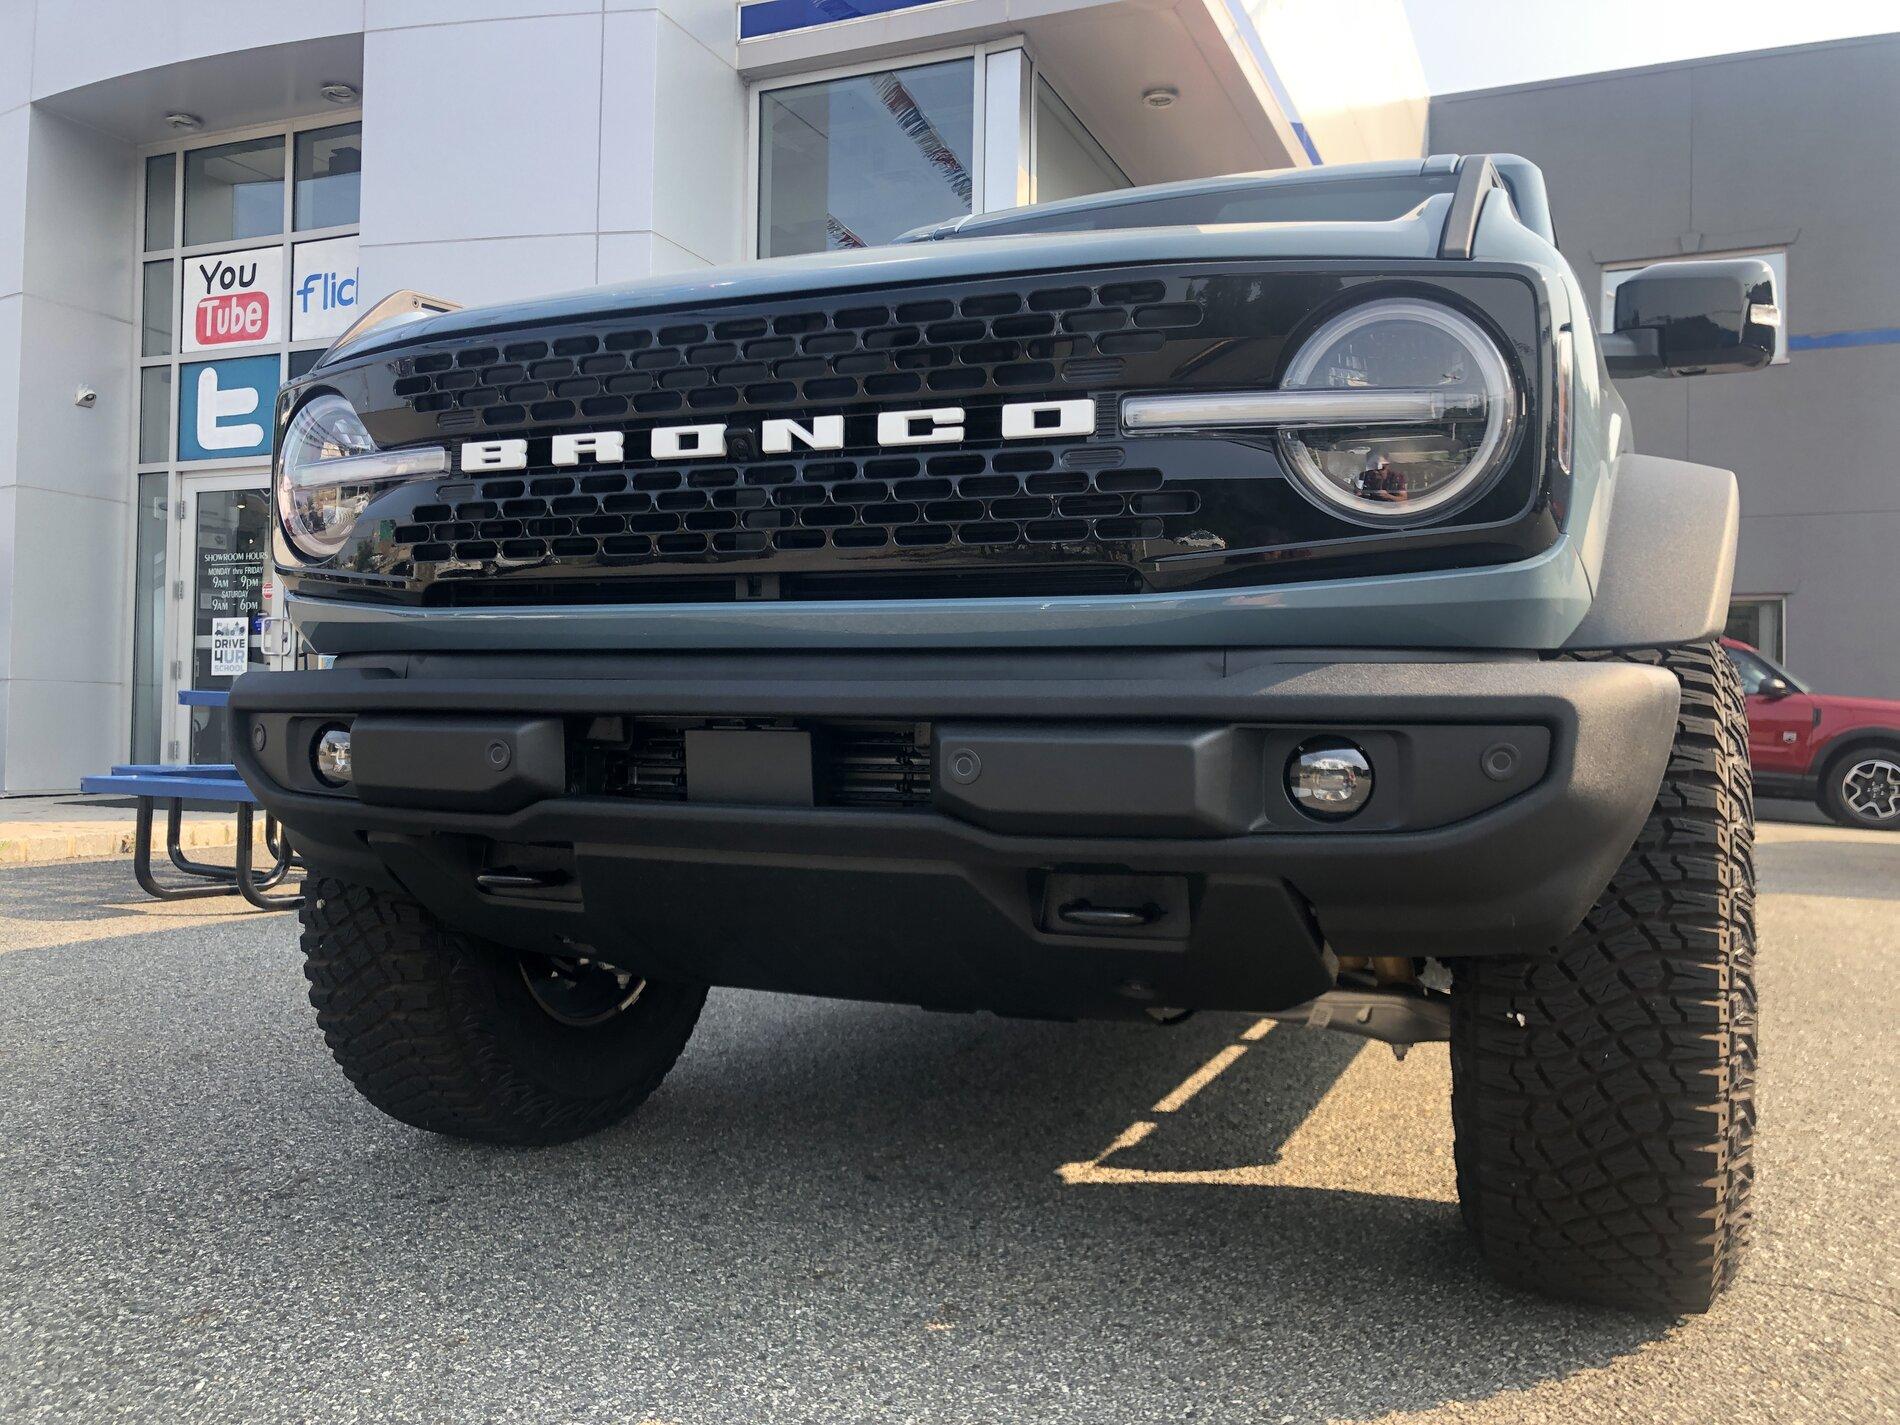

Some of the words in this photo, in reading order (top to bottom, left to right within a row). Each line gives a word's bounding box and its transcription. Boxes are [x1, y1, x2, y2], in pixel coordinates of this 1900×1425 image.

[200, 260, 257, 294] You
[296, 266, 359, 313] flic
[199, 297, 262, 337] Tube
[460, 398, 1096, 473] BRONCO
[204, 553, 244, 562] SHOWROOM
[245, 551, 269, 561] HOURS
[244, 566, 264, 574] FRIDAY
[212, 576, 229, 588] 9AM
[221, 590, 249, 599] SATURDAY
[212, 599, 229, 611] 9AM
[214, 638, 245, 649] DRIVE
[214, 664, 245, 672] SCHOOL
